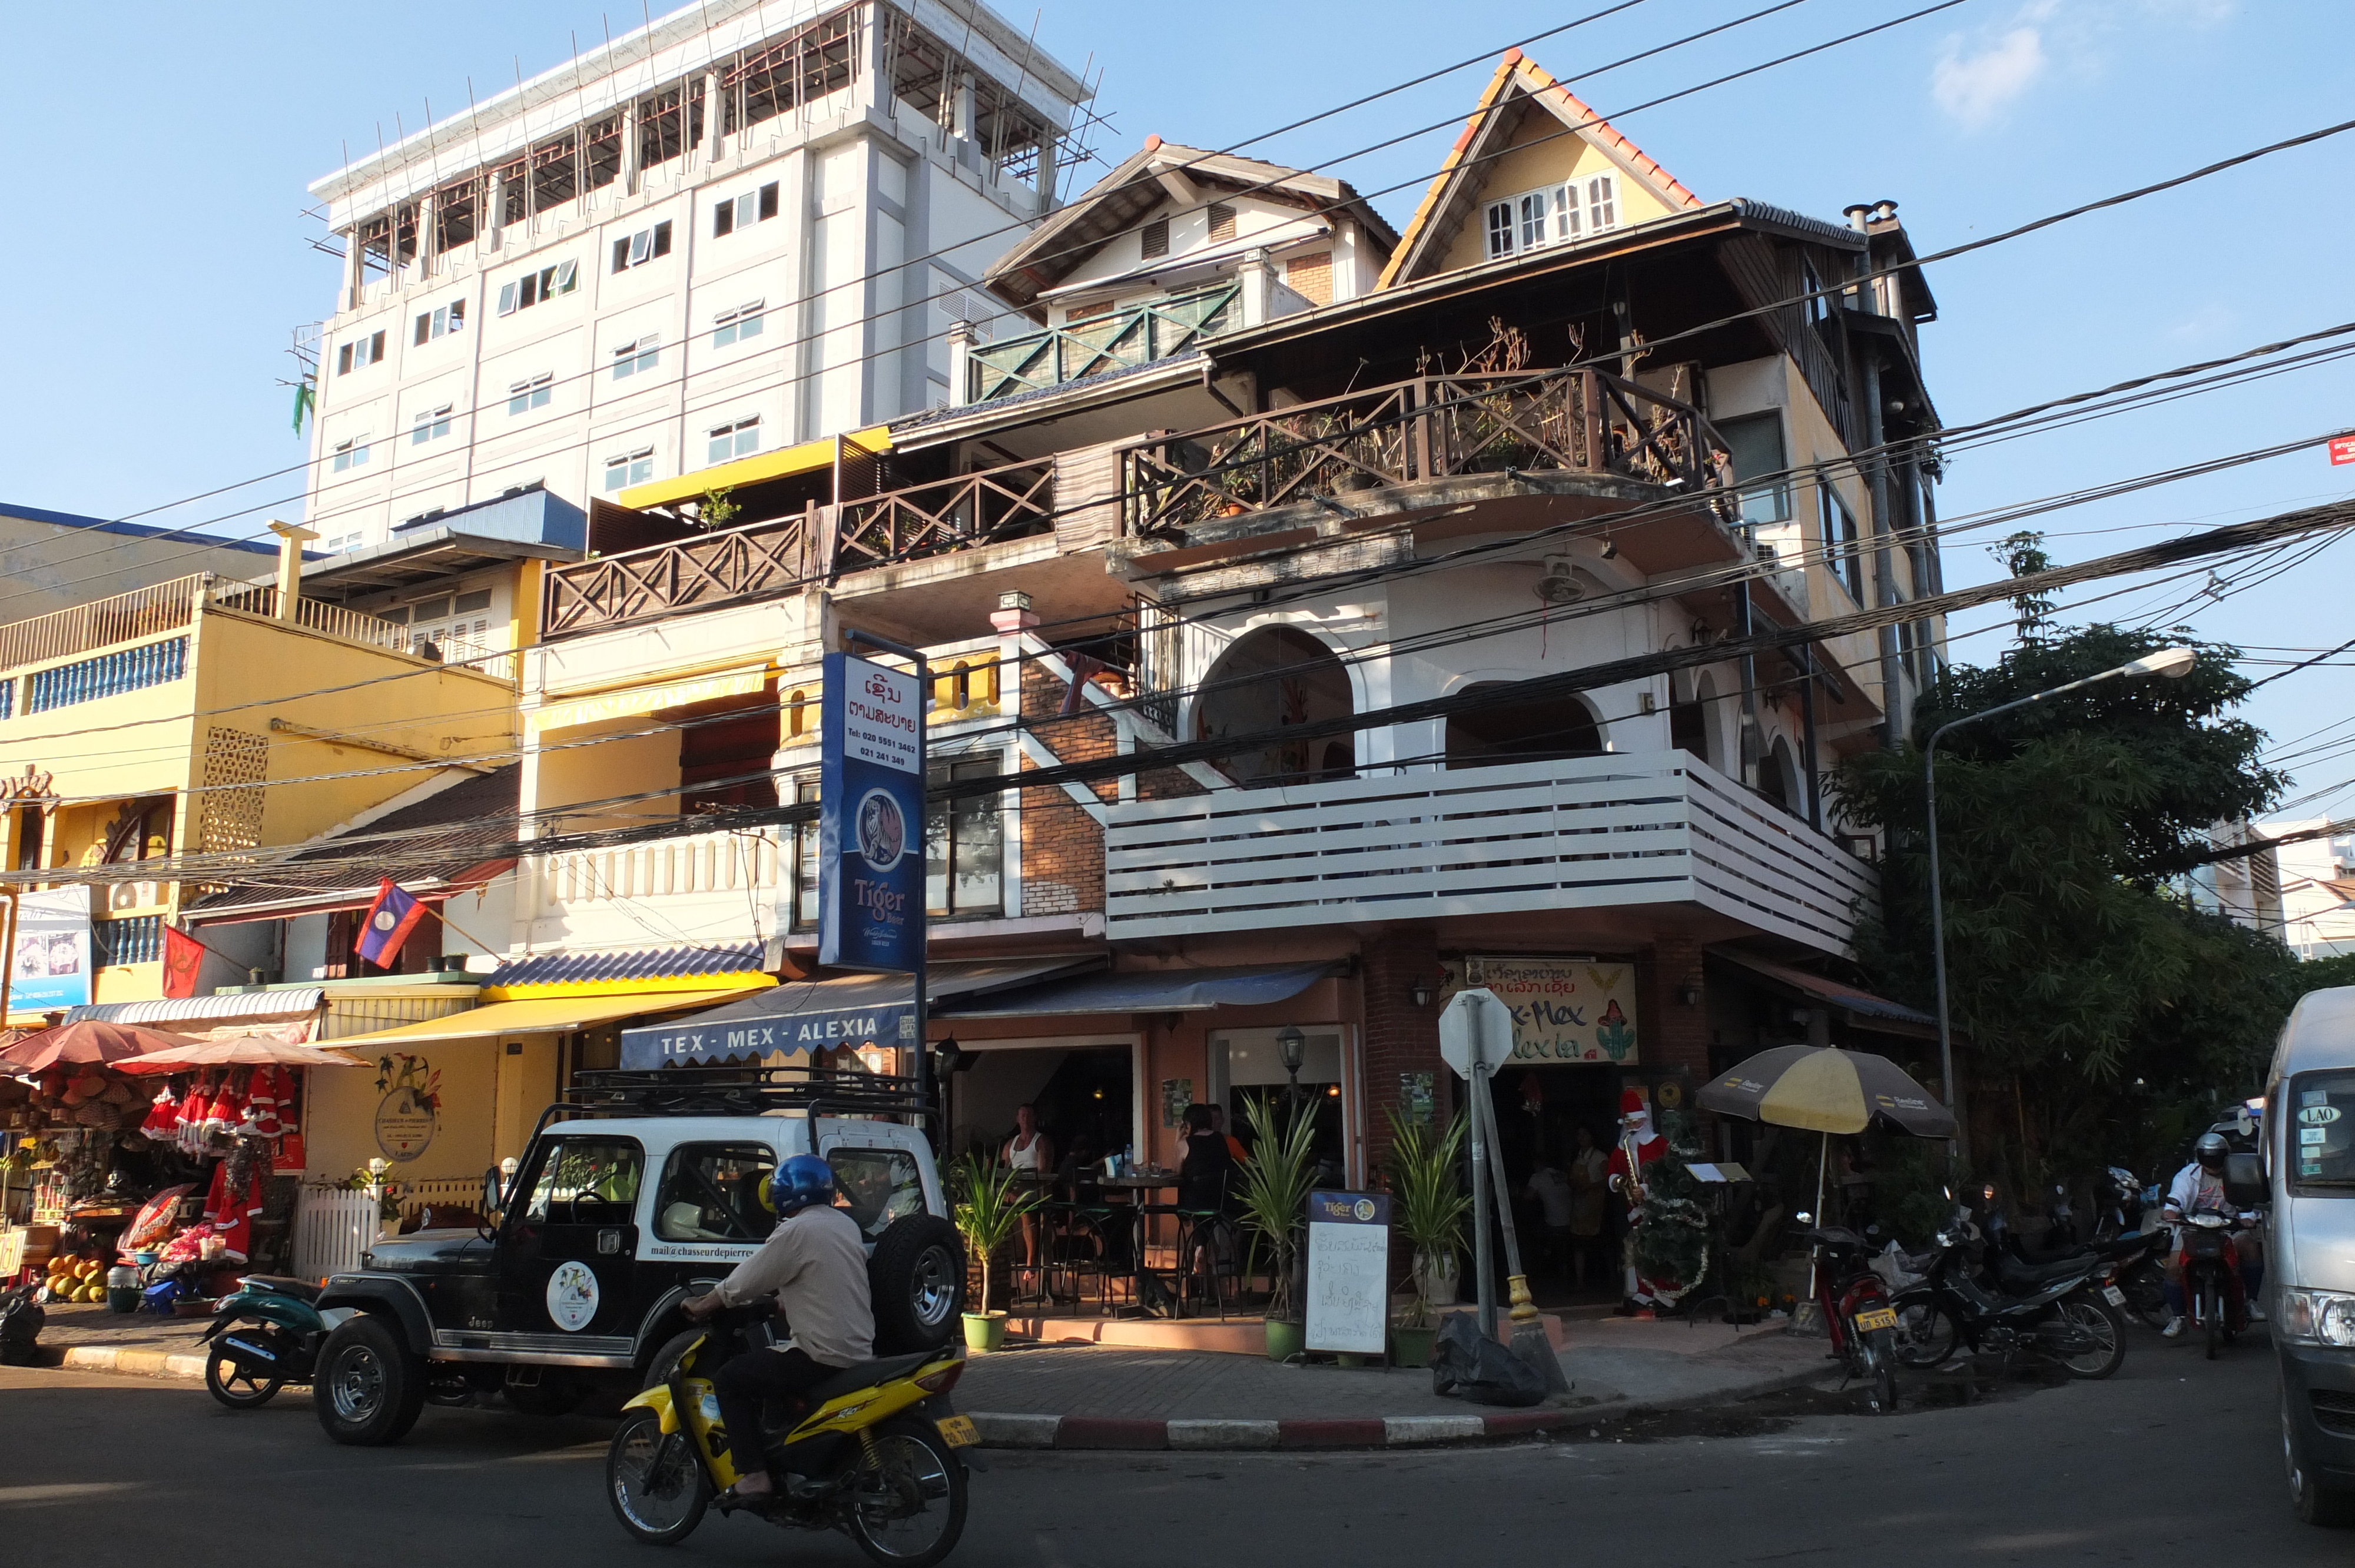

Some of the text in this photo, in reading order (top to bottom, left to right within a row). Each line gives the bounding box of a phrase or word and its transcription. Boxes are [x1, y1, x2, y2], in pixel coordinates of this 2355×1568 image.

[849, 700, 916, 733] ຕາມສະບາຍ
[848, 727, 861, 738] Tel:
[863, 732, 876, 742] 020
[898, 742, 916, 753] 3462
[860, 747, 873, 758] 021
[876, 752, 889, 762] 241
[854, 879, 905, 921] Tiger
[887, 912, 904, 925] Beer
[1507, 1000, 1587, 1032] x-Mex
[661, 1034, 704, 1055] TEX
[727, 1028, 773, 1048] MEX
[798, 1017, 877, 1041] ALEXIA
[1512, 1026, 1580, 1059] lexia
[2307, 1108, 2333, 1122] LAO
[1324, 1202, 1351, 1217] Tiger
[468, 1315, 493, 1330] Jeep
[1875, 1315, 1896, 1327] 5151
